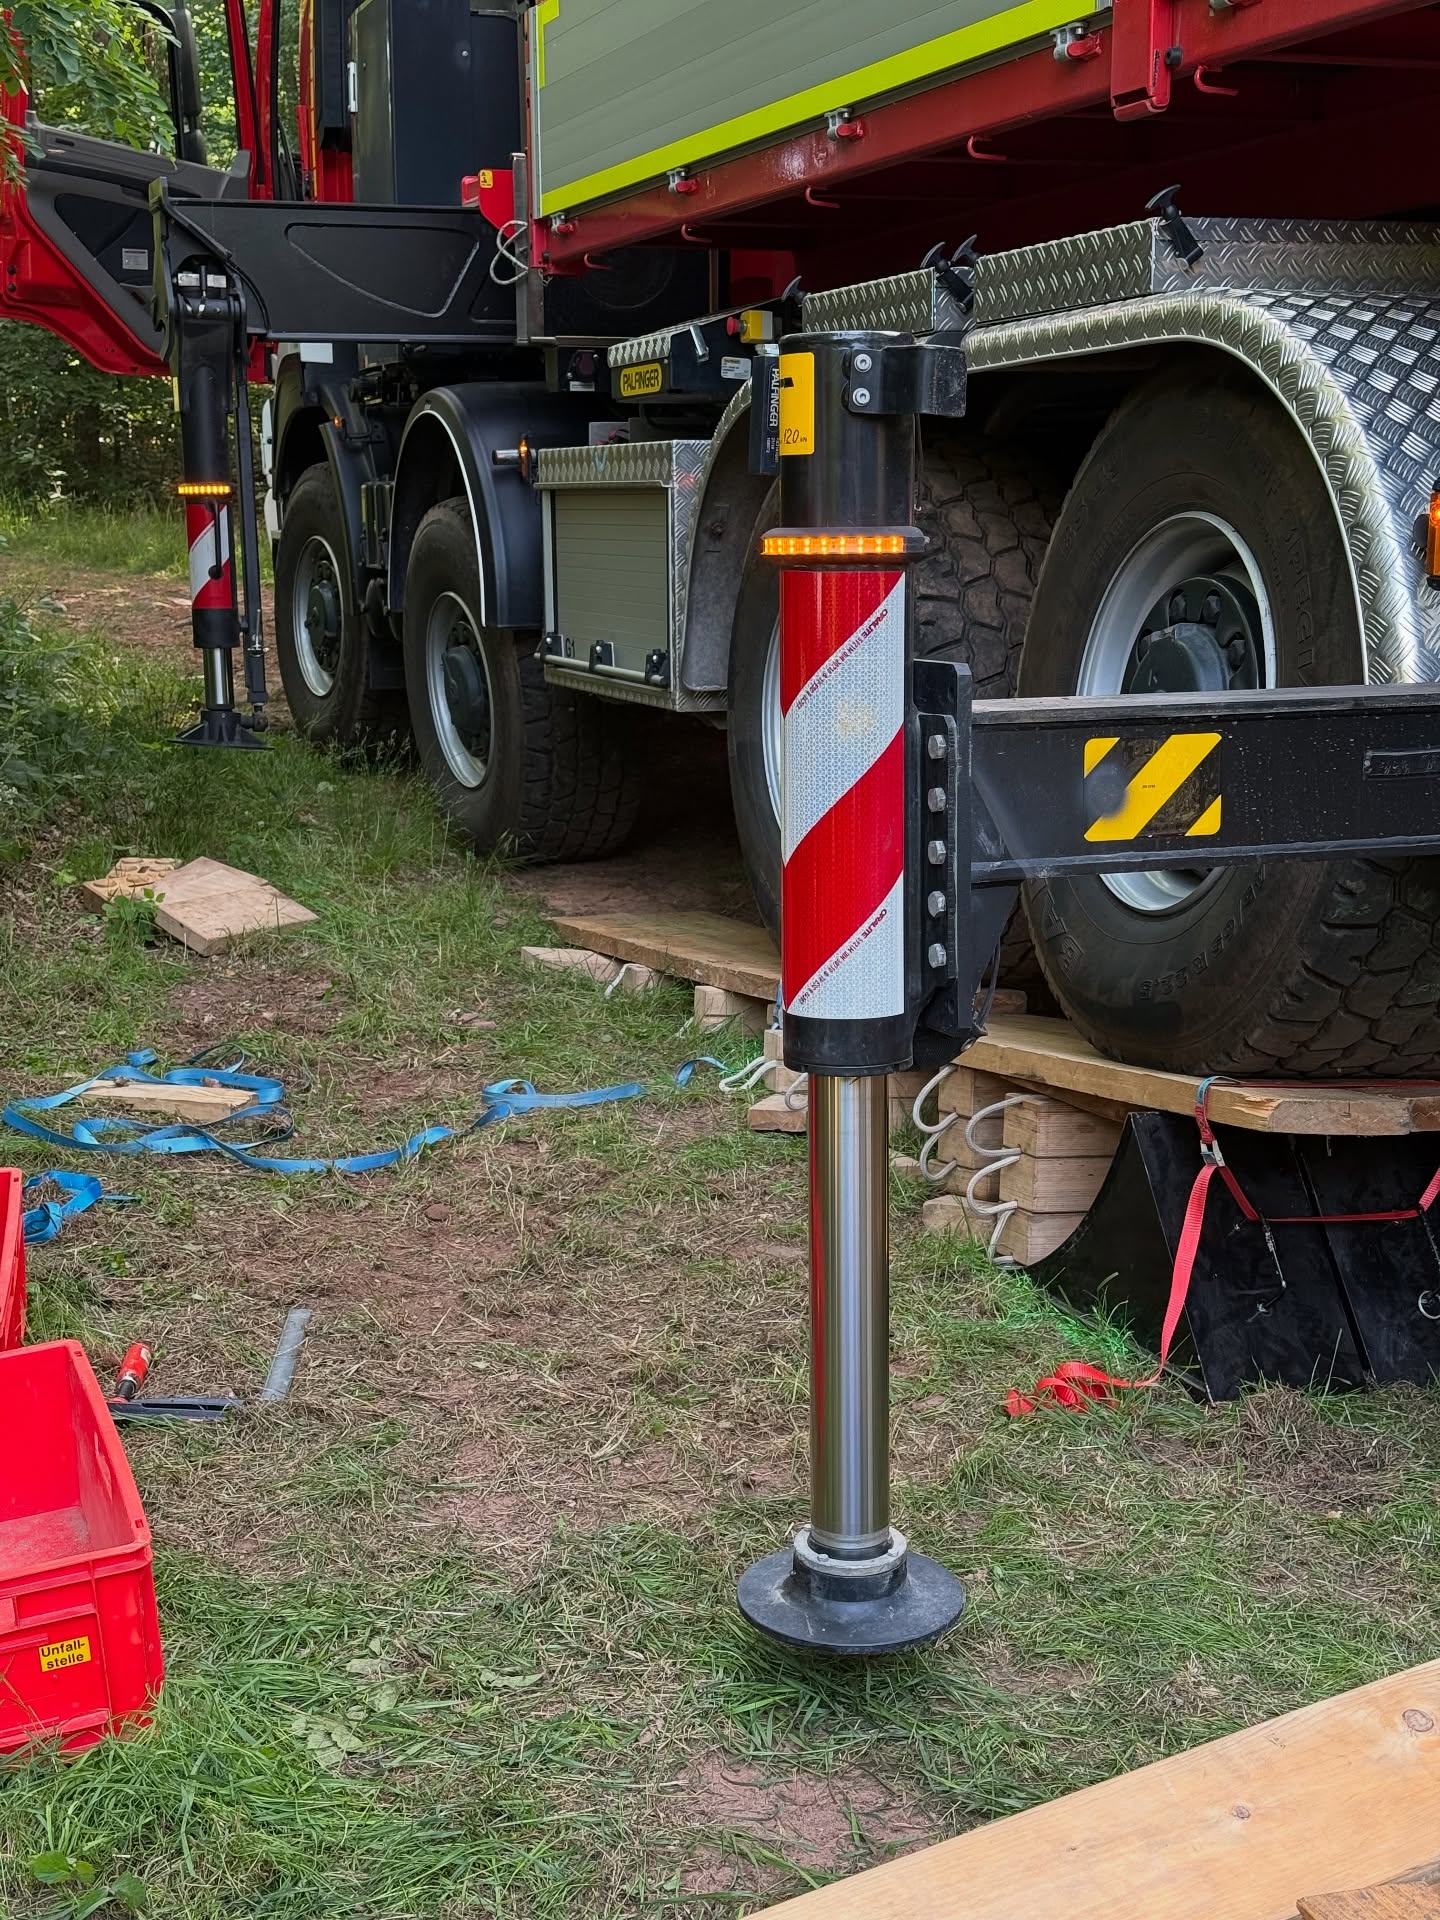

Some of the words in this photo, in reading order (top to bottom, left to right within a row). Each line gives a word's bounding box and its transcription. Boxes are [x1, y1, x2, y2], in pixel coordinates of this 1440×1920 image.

[623, 369, 660, 392] PALFINGER
[769, 368, 780, 427] PALFINGER
[861, 608, 888, 639] ORALITE
[565, 637, 576, 658] G1
[861, 908, 888, 938] ORALITE
[41, 1640, 85, 1657] Unfall-
[46, 1653, 84, 1669] stelle
